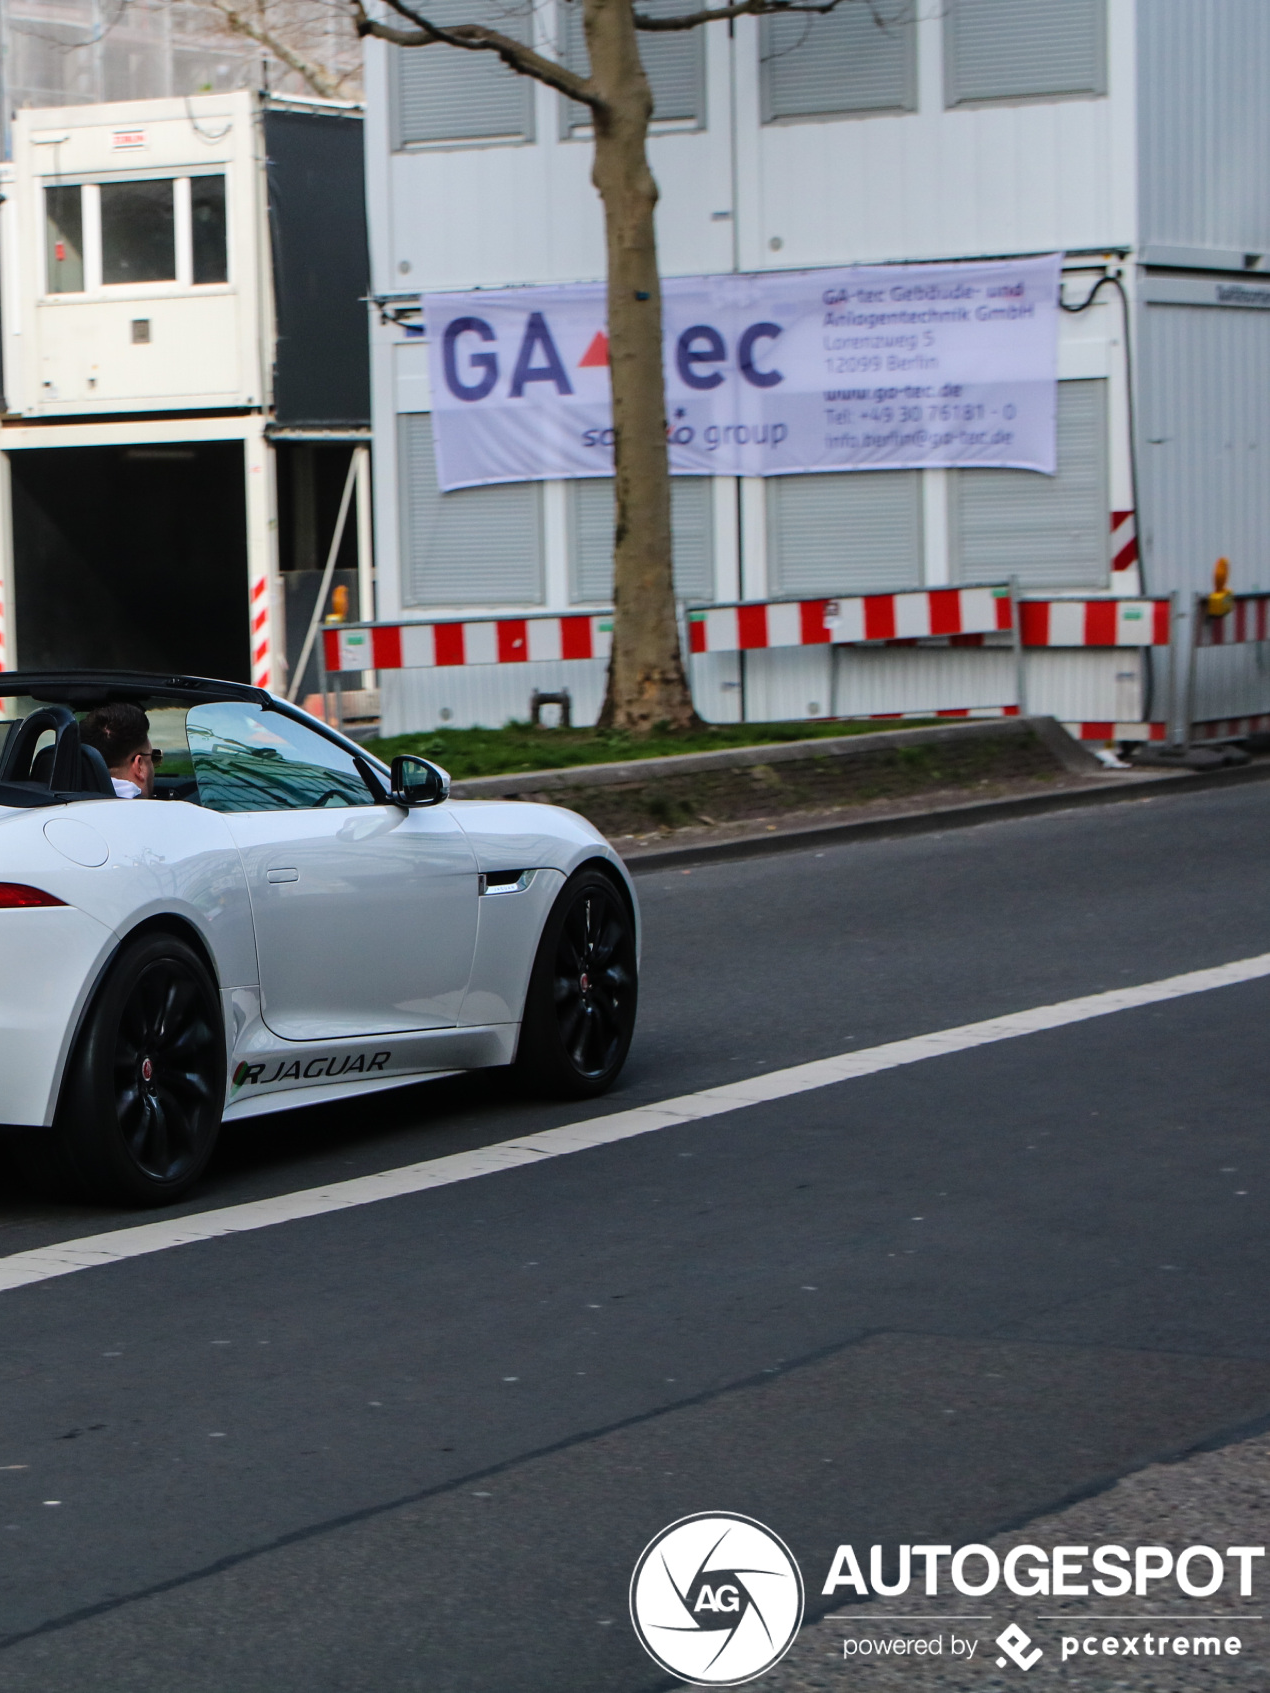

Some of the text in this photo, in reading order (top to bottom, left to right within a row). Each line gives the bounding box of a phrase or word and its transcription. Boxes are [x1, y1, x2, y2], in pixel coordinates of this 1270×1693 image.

[987, 282, 1024, 298] und
[823, 303, 1034, 328] Anlagentechnik GmbH
[923, 330, 934, 347] 5
[675, 322, 784, 391] ec
[887, 353, 939, 372] Berlin
[899, 404, 923, 422] 30
[704, 422, 788, 451] group
[260, 1051, 392, 1084] JAGUAR
